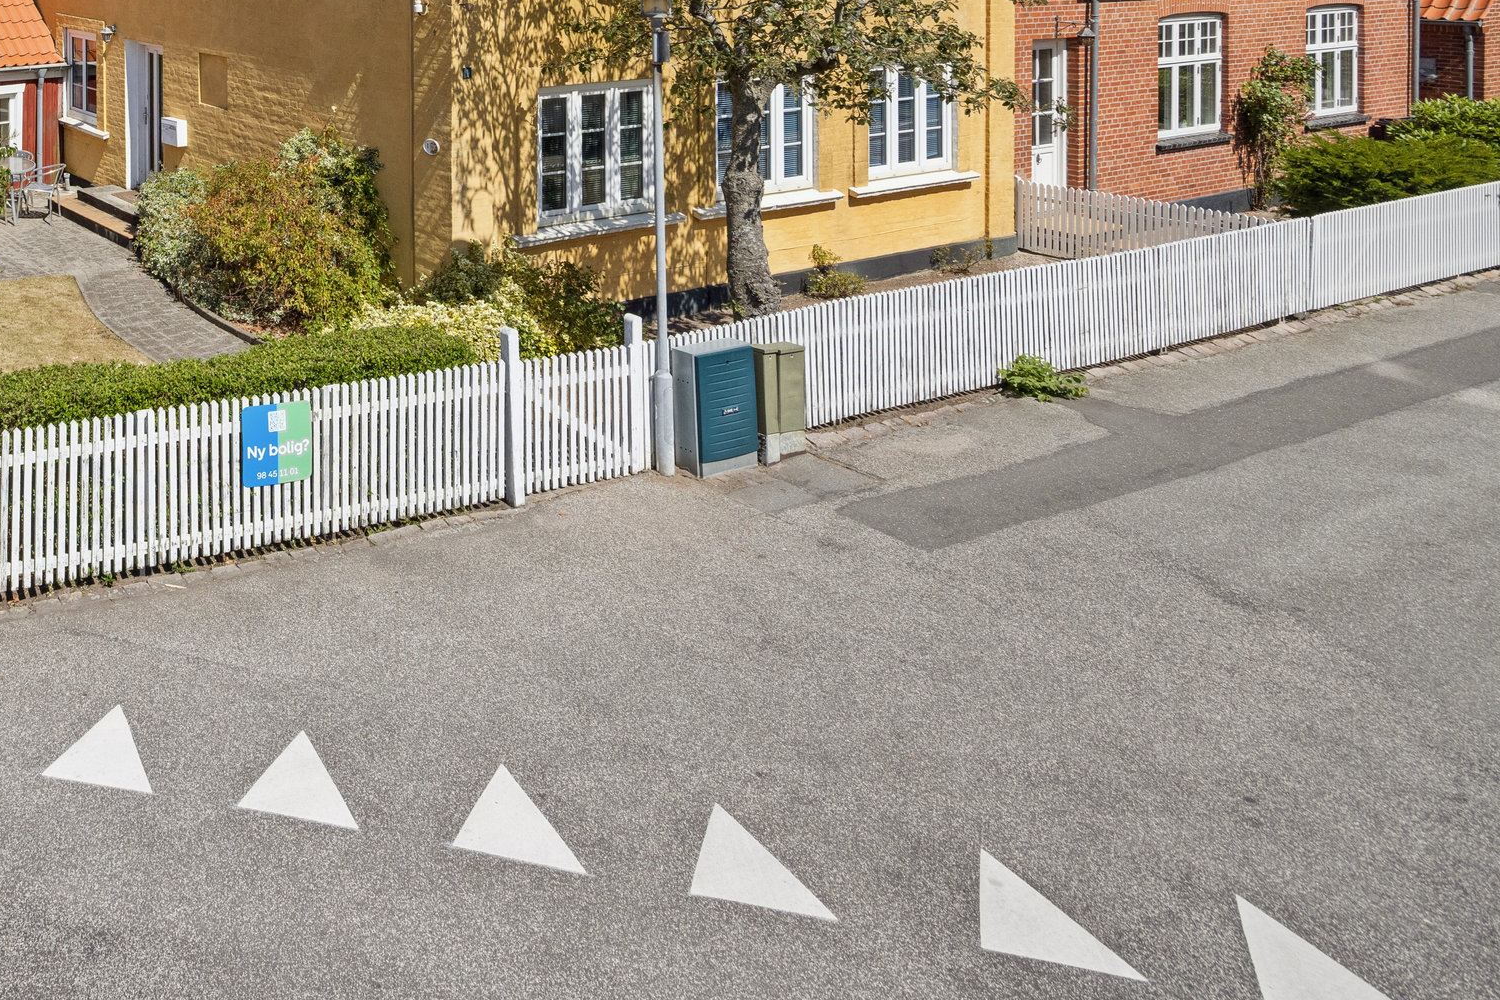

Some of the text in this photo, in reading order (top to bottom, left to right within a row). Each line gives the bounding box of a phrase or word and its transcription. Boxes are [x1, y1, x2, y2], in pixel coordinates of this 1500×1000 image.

[247, 438, 310, 461] Ny bolig?
[256, 467, 299, 480] 98 45 11 01
